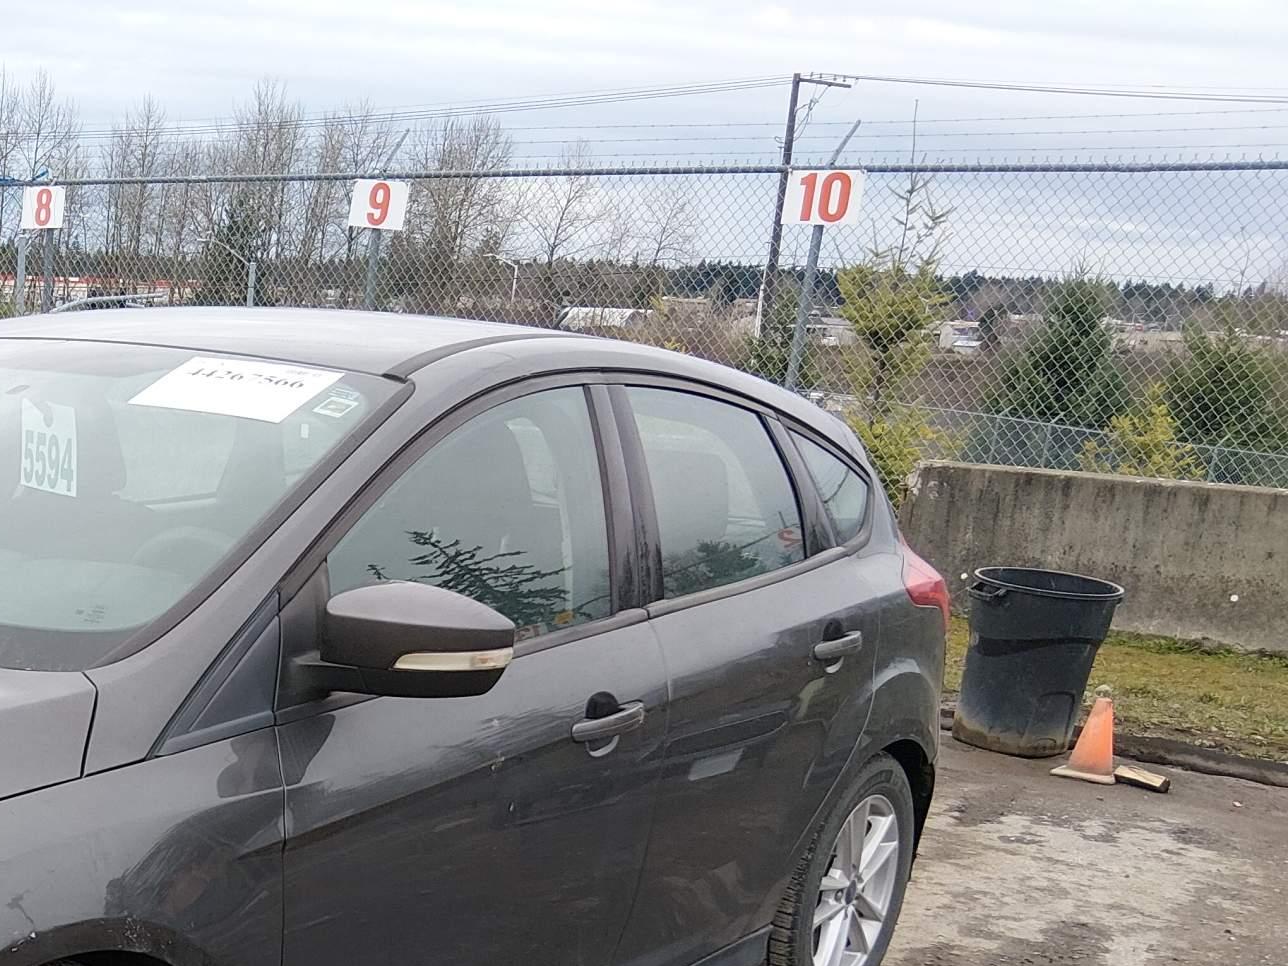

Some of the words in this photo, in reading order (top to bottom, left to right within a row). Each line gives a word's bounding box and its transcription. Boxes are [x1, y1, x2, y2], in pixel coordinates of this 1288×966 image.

[34, 188, 52, 226] 8
[366, 182, 392, 226] 9
[800, 171, 852, 223] 10
[23, 429, 74, 493] 5594
